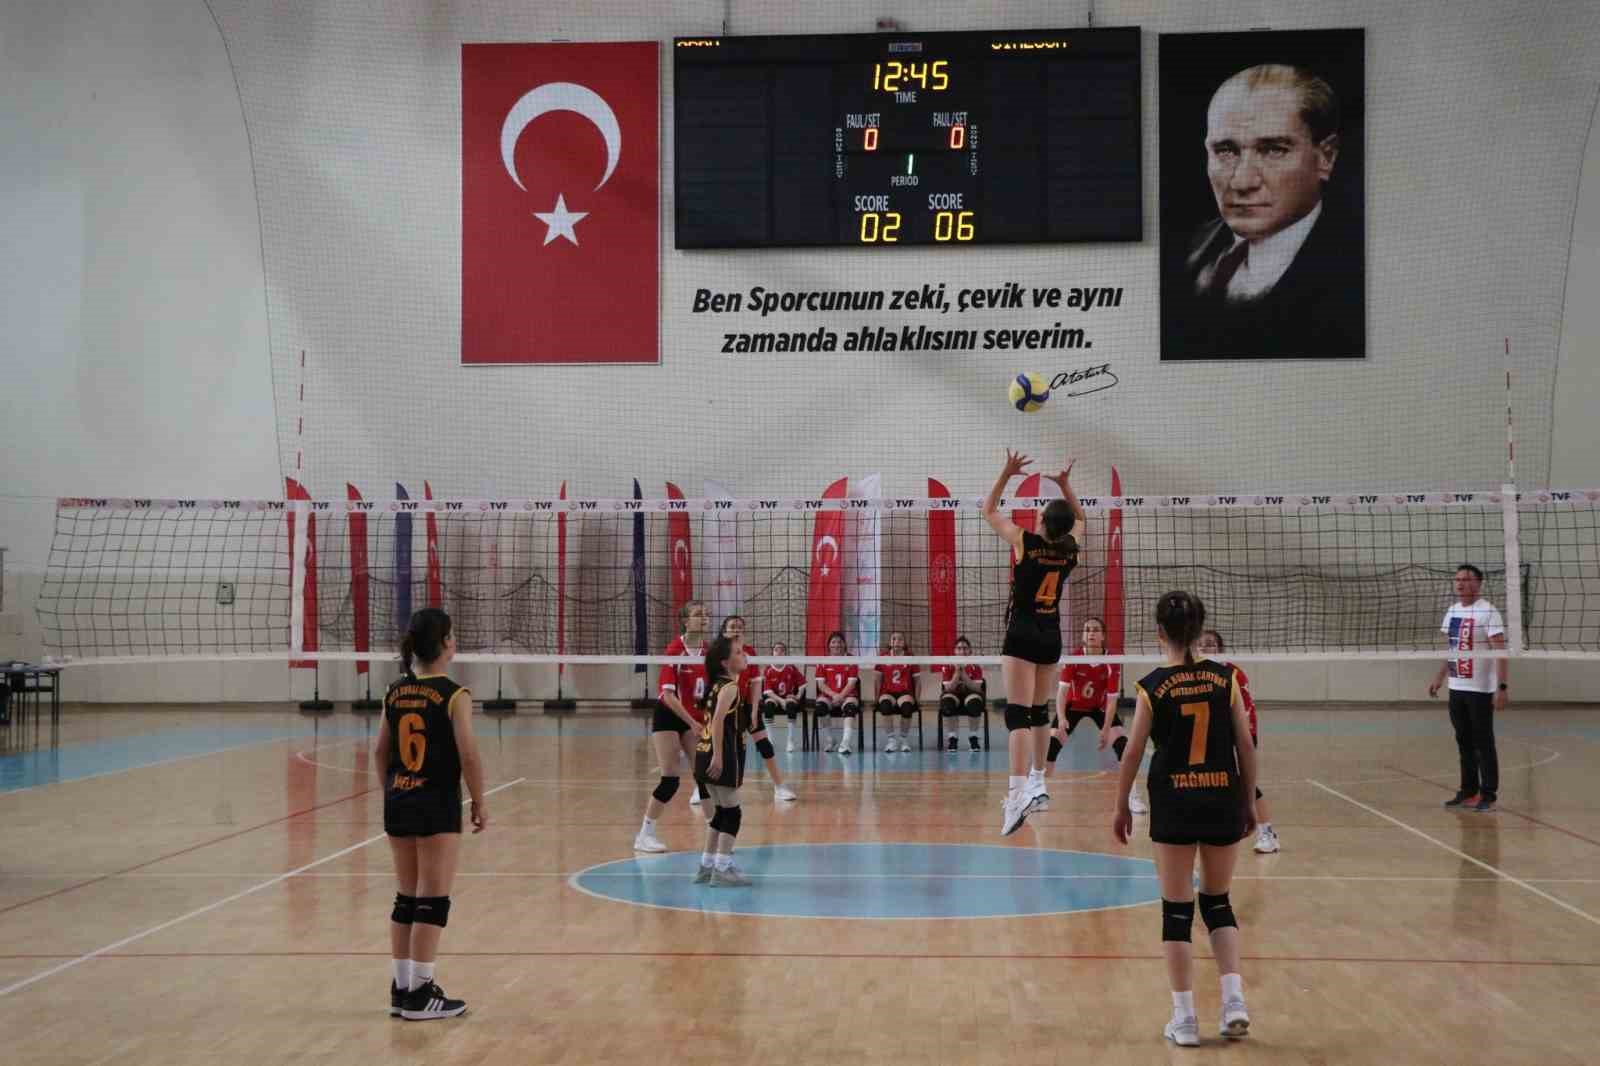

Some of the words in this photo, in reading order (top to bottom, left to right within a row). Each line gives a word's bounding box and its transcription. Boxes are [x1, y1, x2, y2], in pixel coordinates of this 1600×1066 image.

[875, 61, 948, 91] 12:45
[895, 91, 917, 103] TIME
[846, 113, 881, 128] FAUL/SET
[932, 112, 968, 127] FAUL/SET
[864, 128, 878, 150] 0
[950, 127, 964, 149] 0
[907, 153, 914, 175] 1
[890, 176, 919, 187] PERIOD
[854, 195, 889, 211] SCORE
[928, 193, 963, 210] SCORE
[861, 213, 901, 242] 02
[935, 211, 974, 241] 06
[692, 288, 743, 313] Ben
[747, 286, 885, 317] Sporcunun
[888, 283, 950, 314] zeki,
[957, 282, 1026, 313] çevik
[1033, 287, 1062, 308] ve
[1067, 287, 1123, 312] aynı
[721, 326, 838, 353] zamanda
[843, 325, 977, 352] ahlaklısını
[982, 322, 1093, 350] severim.
[90, 499, 107, 507] TVF
[1125, 498, 1144, 506] TVF
[1455, 494, 1473, 502] TVF
[1551, 492, 1570, 500] TVF
[1035, 571, 1060, 607] 4
[892, 670, 901, 684] 2
[1082, 681, 1094, 698] 6
[398, 713, 427, 773] 6
[1181, 701, 1210, 765] 7
